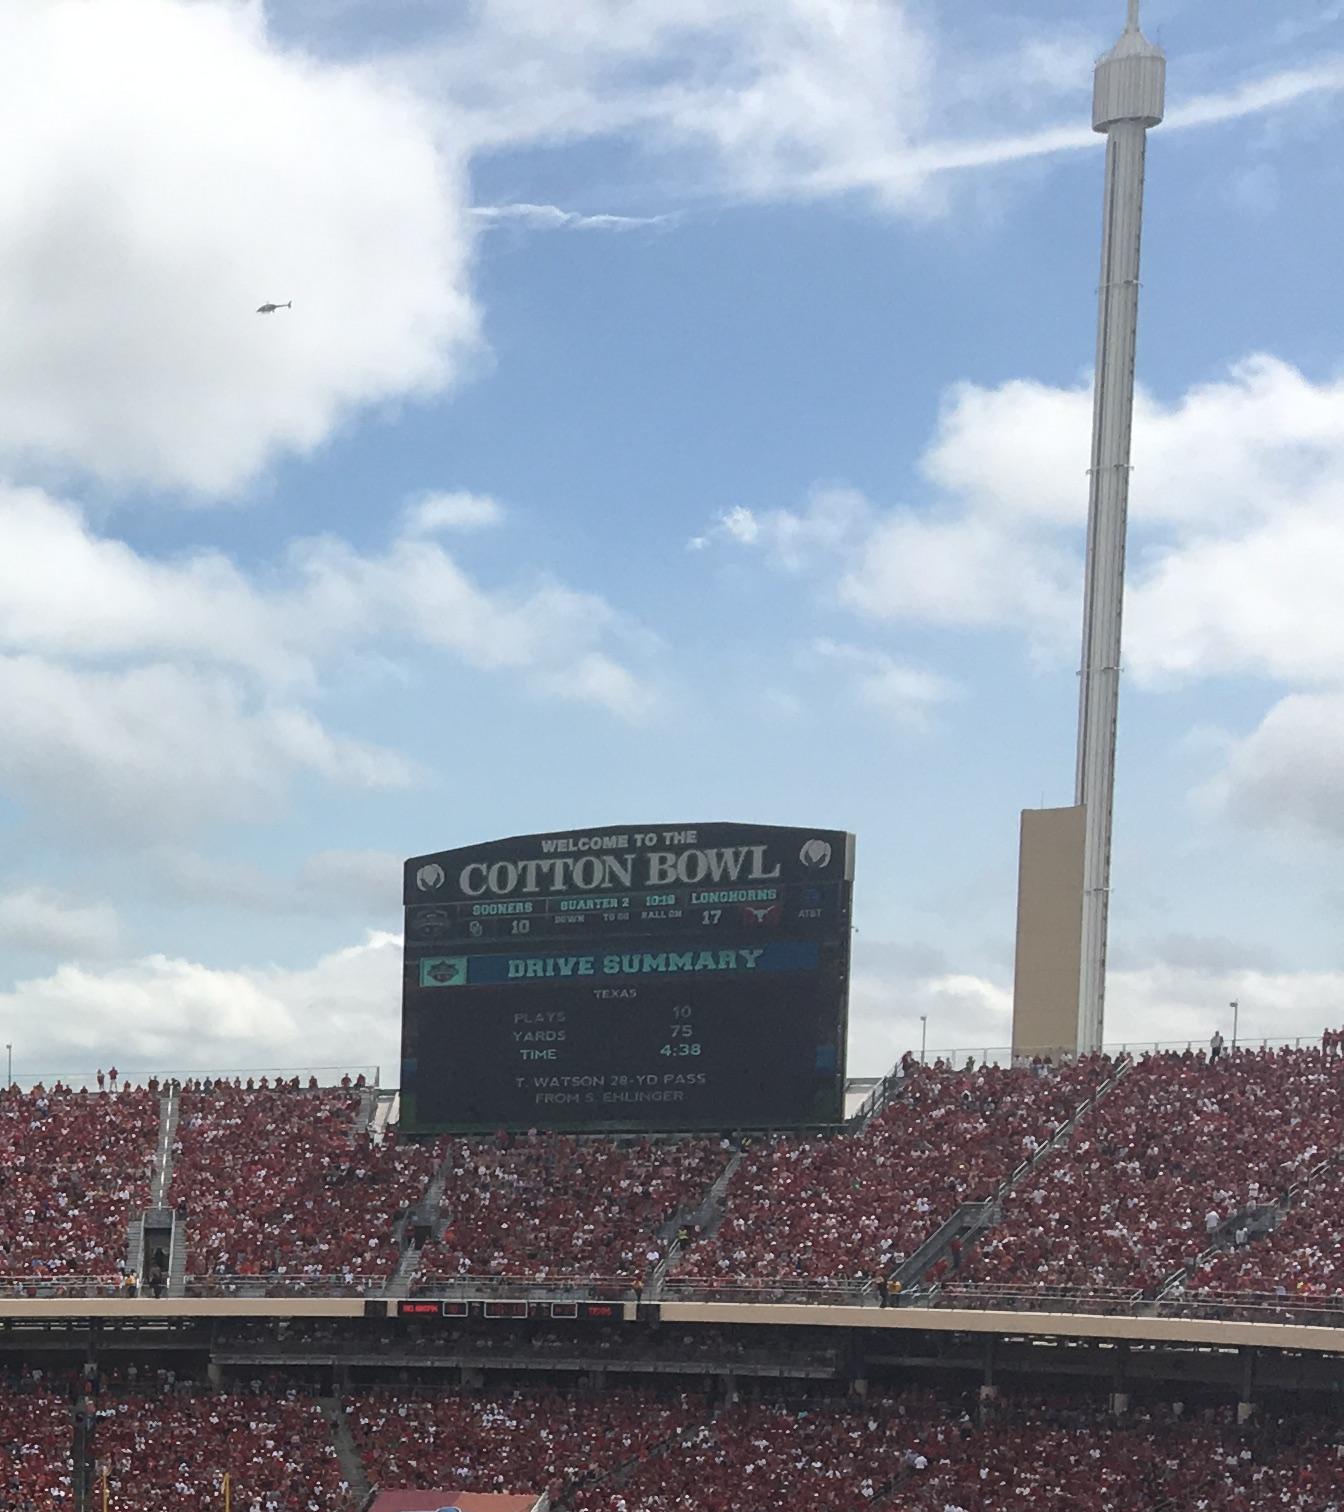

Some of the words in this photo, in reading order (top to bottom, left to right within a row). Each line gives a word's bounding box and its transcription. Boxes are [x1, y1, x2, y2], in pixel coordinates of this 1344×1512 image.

[542, 835, 628, 853] WELCOME
[634, 833, 657, 847] TO
[664, 831, 697, 844] THE
[460, 855, 632, 896] COTTON
[645, 845, 780, 885] BOWL
[692, 889, 776, 904] LONGHORNS
[473, 903, 533, 915] SOONERS
[702, 910, 721, 924] 17
[512, 920, 530, 934] 10
[508, 957, 594, 977] DRIVE
[603, 950, 763, 974] SUMMARY
[593, 989, 637, 999] TEXAS
[514, 1012, 565, 1024] PLAYS
[673, 1006, 691, 1018] 10
[513, 1031, 566, 1042] YARDS
[670, 1025, 692, 1037] 75
[520, 1049, 557, 1059] TIME
[660, 1044, 701, 1056] 4:38
[534, 1076, 605, 1087] WATSON
[611, 1075, 658, 1085] 28-YD
[664, 1073, 706, 1084] PASS
[536, 1093, 579, 1103] FROM
[603, 1091, 684, 1102] EHLINGER
